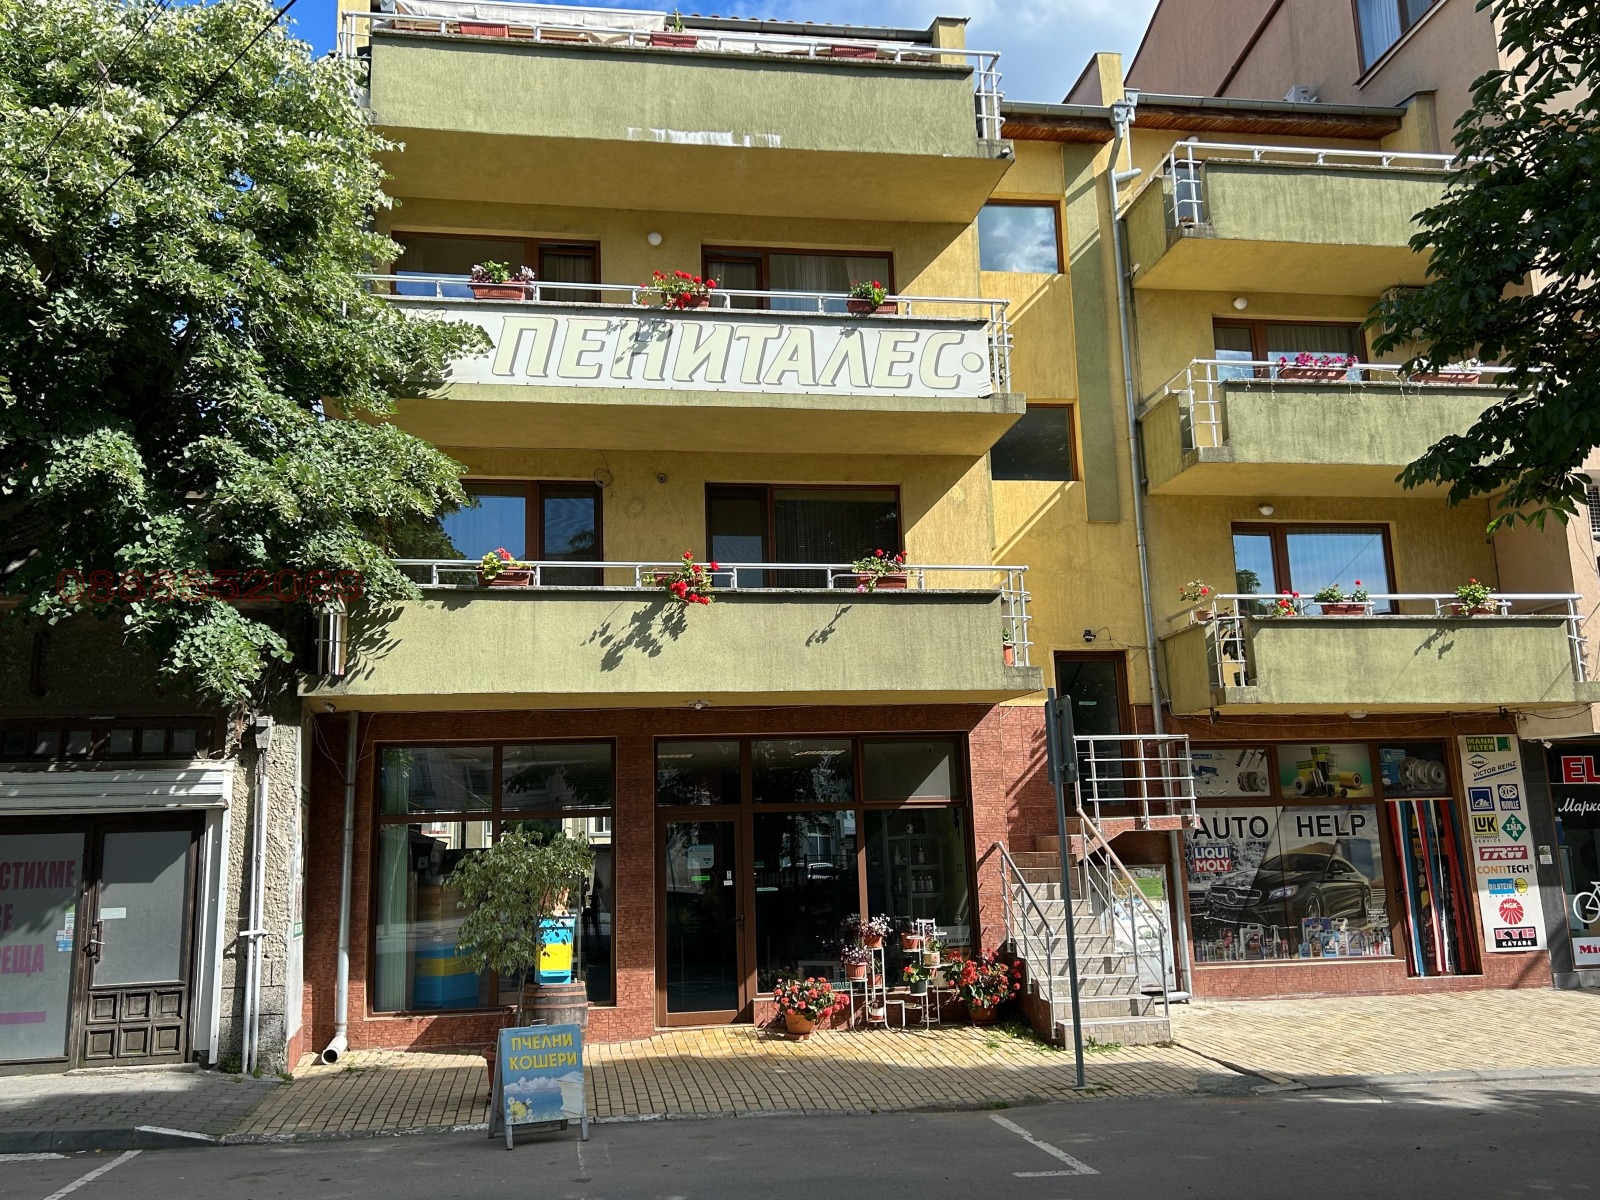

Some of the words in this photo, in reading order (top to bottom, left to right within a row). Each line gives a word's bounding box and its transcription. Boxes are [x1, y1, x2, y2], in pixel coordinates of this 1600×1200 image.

[492, 315, 965, 389] ПЕНИТАЛЕС
[1473, 767, 1496, 778] VICTOR
[1498, 760, 1517, 770] REINZ
[1193, 815, 1269, 839] AUTO
[1296, 814, 1366, 838] HELP
[1194, 846, 1229, 860] LIQUI
[1481, 846, 1525, 860] TRW
[1195, 859, 1231, 872] MOLY
[1488, 882, 1513, 891] BILSTEIN
[1495, 928, 1536, 940] KYB
[511, 1033, 573, 1051] ПЧЕЛНИ
[508, 1051, 577, 1071] КОШЕРИ
